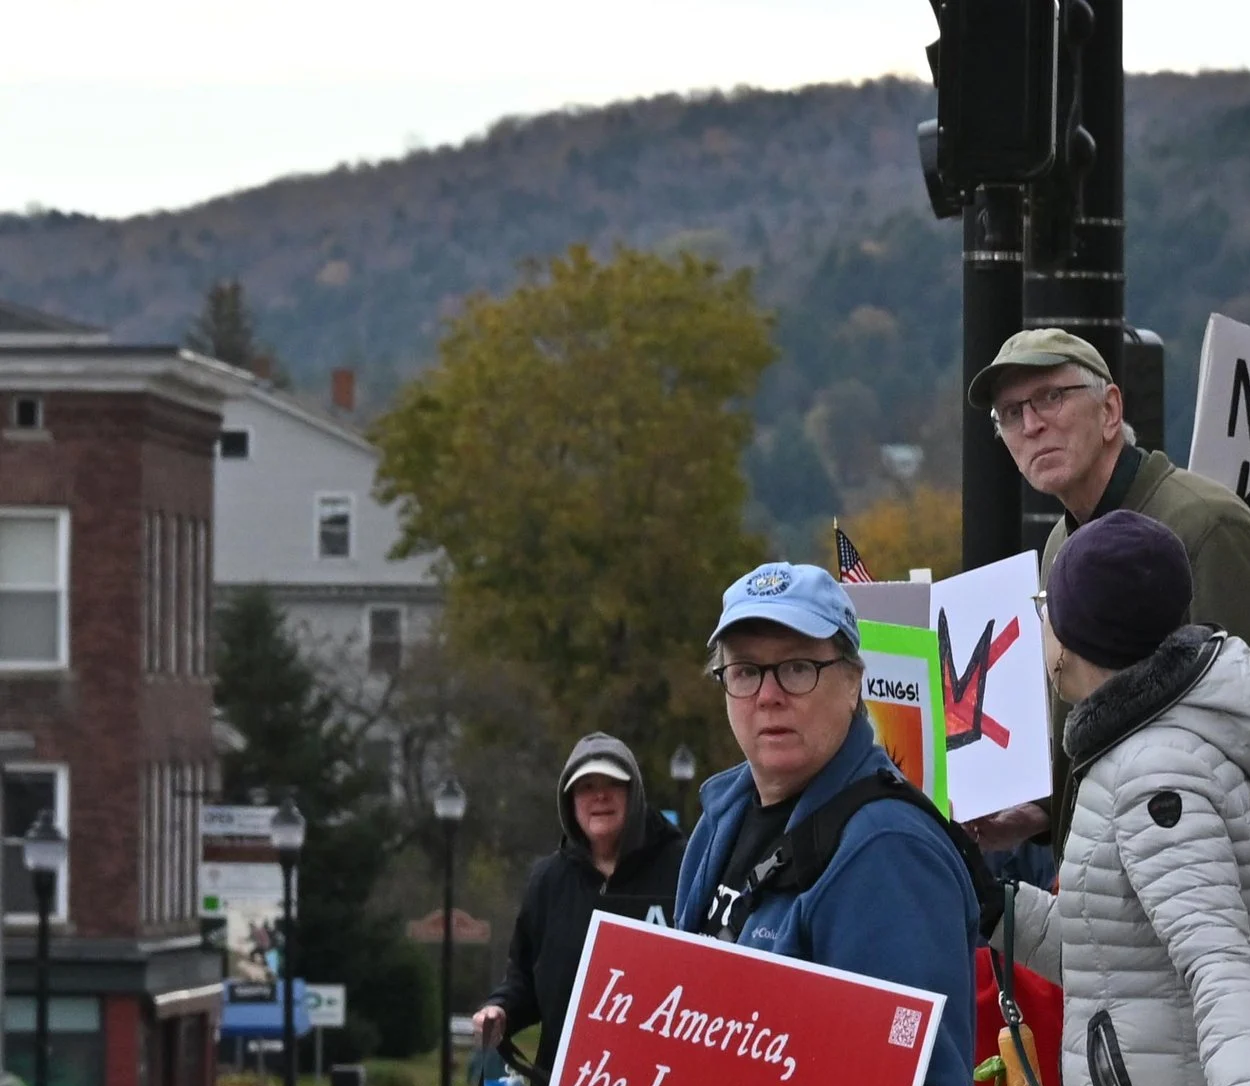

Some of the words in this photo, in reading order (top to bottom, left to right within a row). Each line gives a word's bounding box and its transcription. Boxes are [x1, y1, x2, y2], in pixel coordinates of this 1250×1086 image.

[867, 678, 920, 701] KINGS!
[588, 968, 634, 1025] In
[639, 984, 798, 1081] America,
